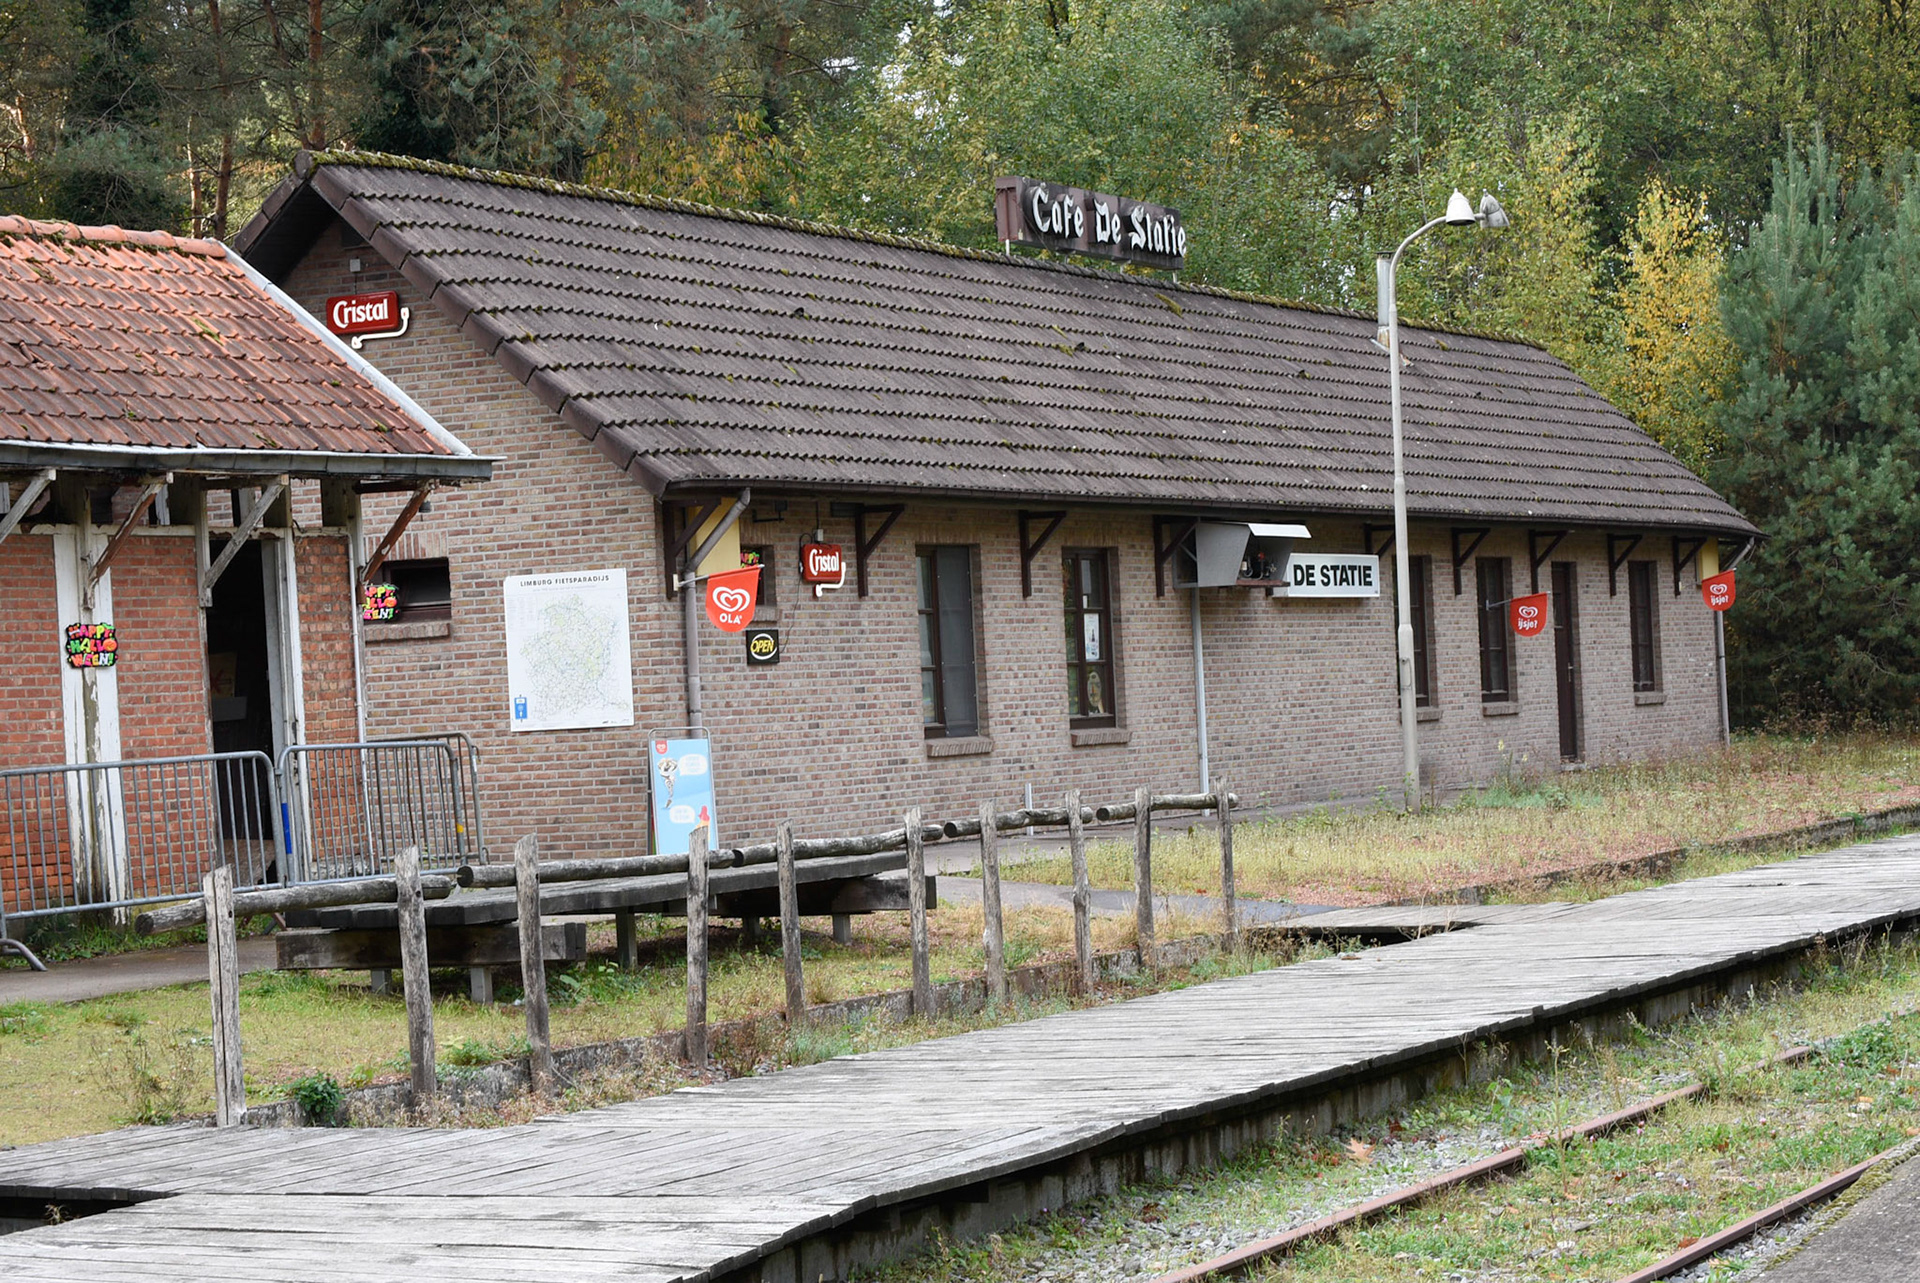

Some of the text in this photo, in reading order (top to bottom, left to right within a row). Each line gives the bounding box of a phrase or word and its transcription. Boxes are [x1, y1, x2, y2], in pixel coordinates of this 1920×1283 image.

[1032, 187, 1187, 258] Cafe De Statie
[332, 298, 389, 329] Cristal
[809, 549, 839, 576] Cristal
[520, 578, 553, 588] LIMBURG
[555, 575, 610, 585] FIETSPARADIJS
[1293, 564, 1374, 587] DE STATIE
[719, 613, 741, 625] OLA
[68, 623, 115, 639] HAPPY
[750, 639, 775, 653] OPEN
